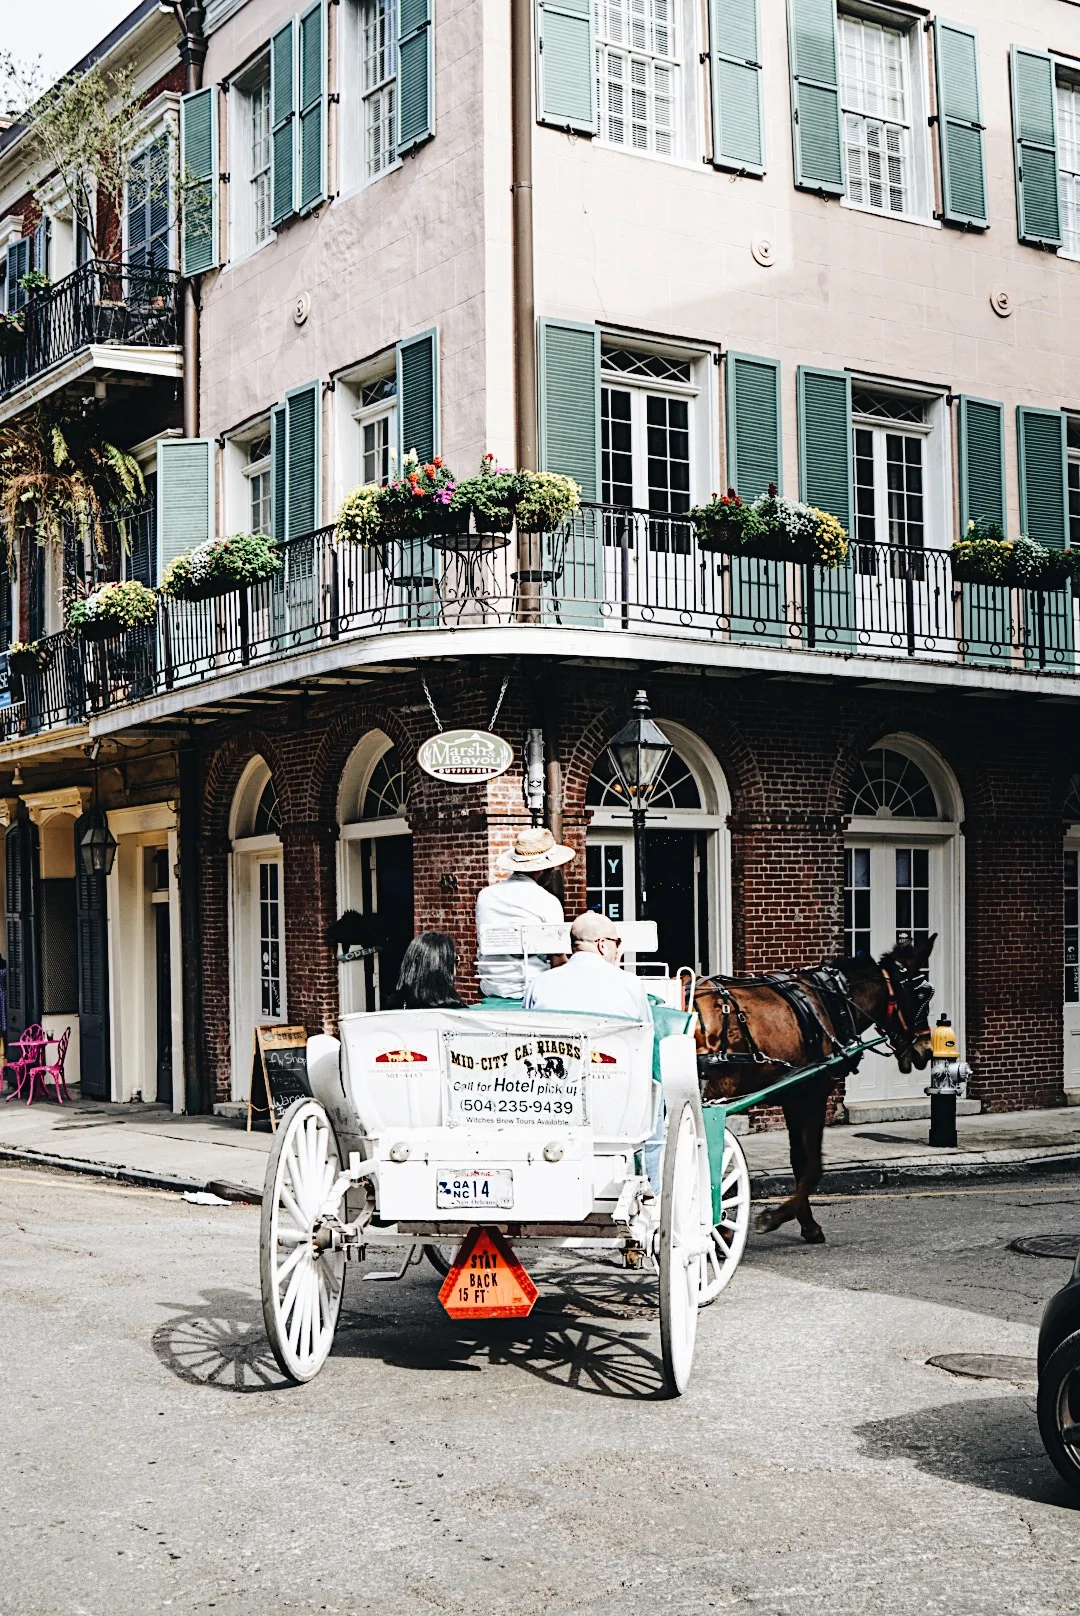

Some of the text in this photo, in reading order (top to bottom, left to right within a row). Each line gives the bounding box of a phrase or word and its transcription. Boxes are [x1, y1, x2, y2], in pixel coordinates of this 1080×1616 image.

[430, 742, 487, 764] Marsh
[451, 755, 501, 766] Bayou
[345, 946, 376, 960] OPEN
[450, 1040, 581, 1071] MID-CITY CARIAGES
[476, 1081, 492, 1092] for
[494, 1077, 535, 1093] Hotel
[537, 1082, 562, 1096] pick
[498, 1100, 573, 1114] 235-9439
[516, 1117, 535, 1125] Tours
[537, 1117, 569, 1126] Available
[453, 1190, 470, 1198] NC
[473, 1180, 489, 1198] 14
[471, 1254, 497, 1269] STAY
[470, 1273, 498, 1288] BACK
[459, 1288, 486, 1303] 15 FT
